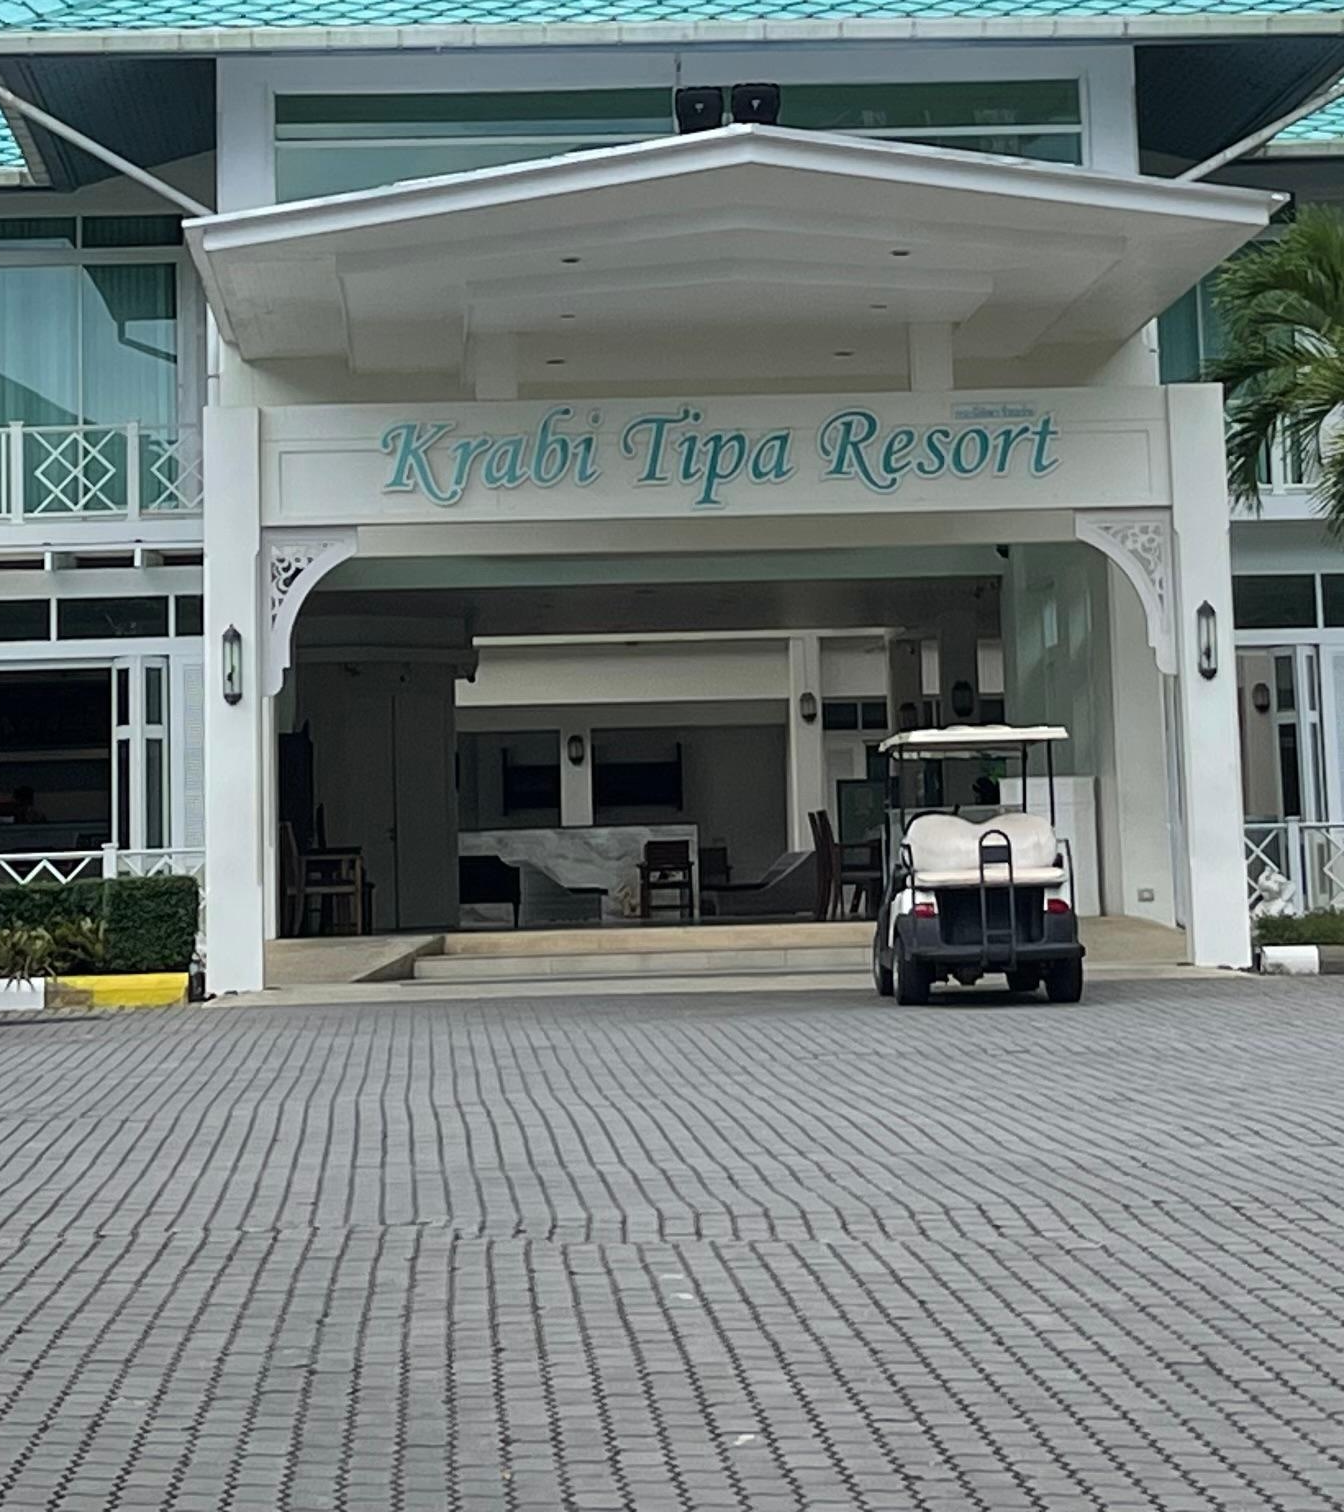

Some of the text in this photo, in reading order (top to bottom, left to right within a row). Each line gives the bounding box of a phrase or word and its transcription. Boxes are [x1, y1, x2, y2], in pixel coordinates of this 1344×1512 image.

[379, 405, 1061, 508] Krabi Tipa Resort
